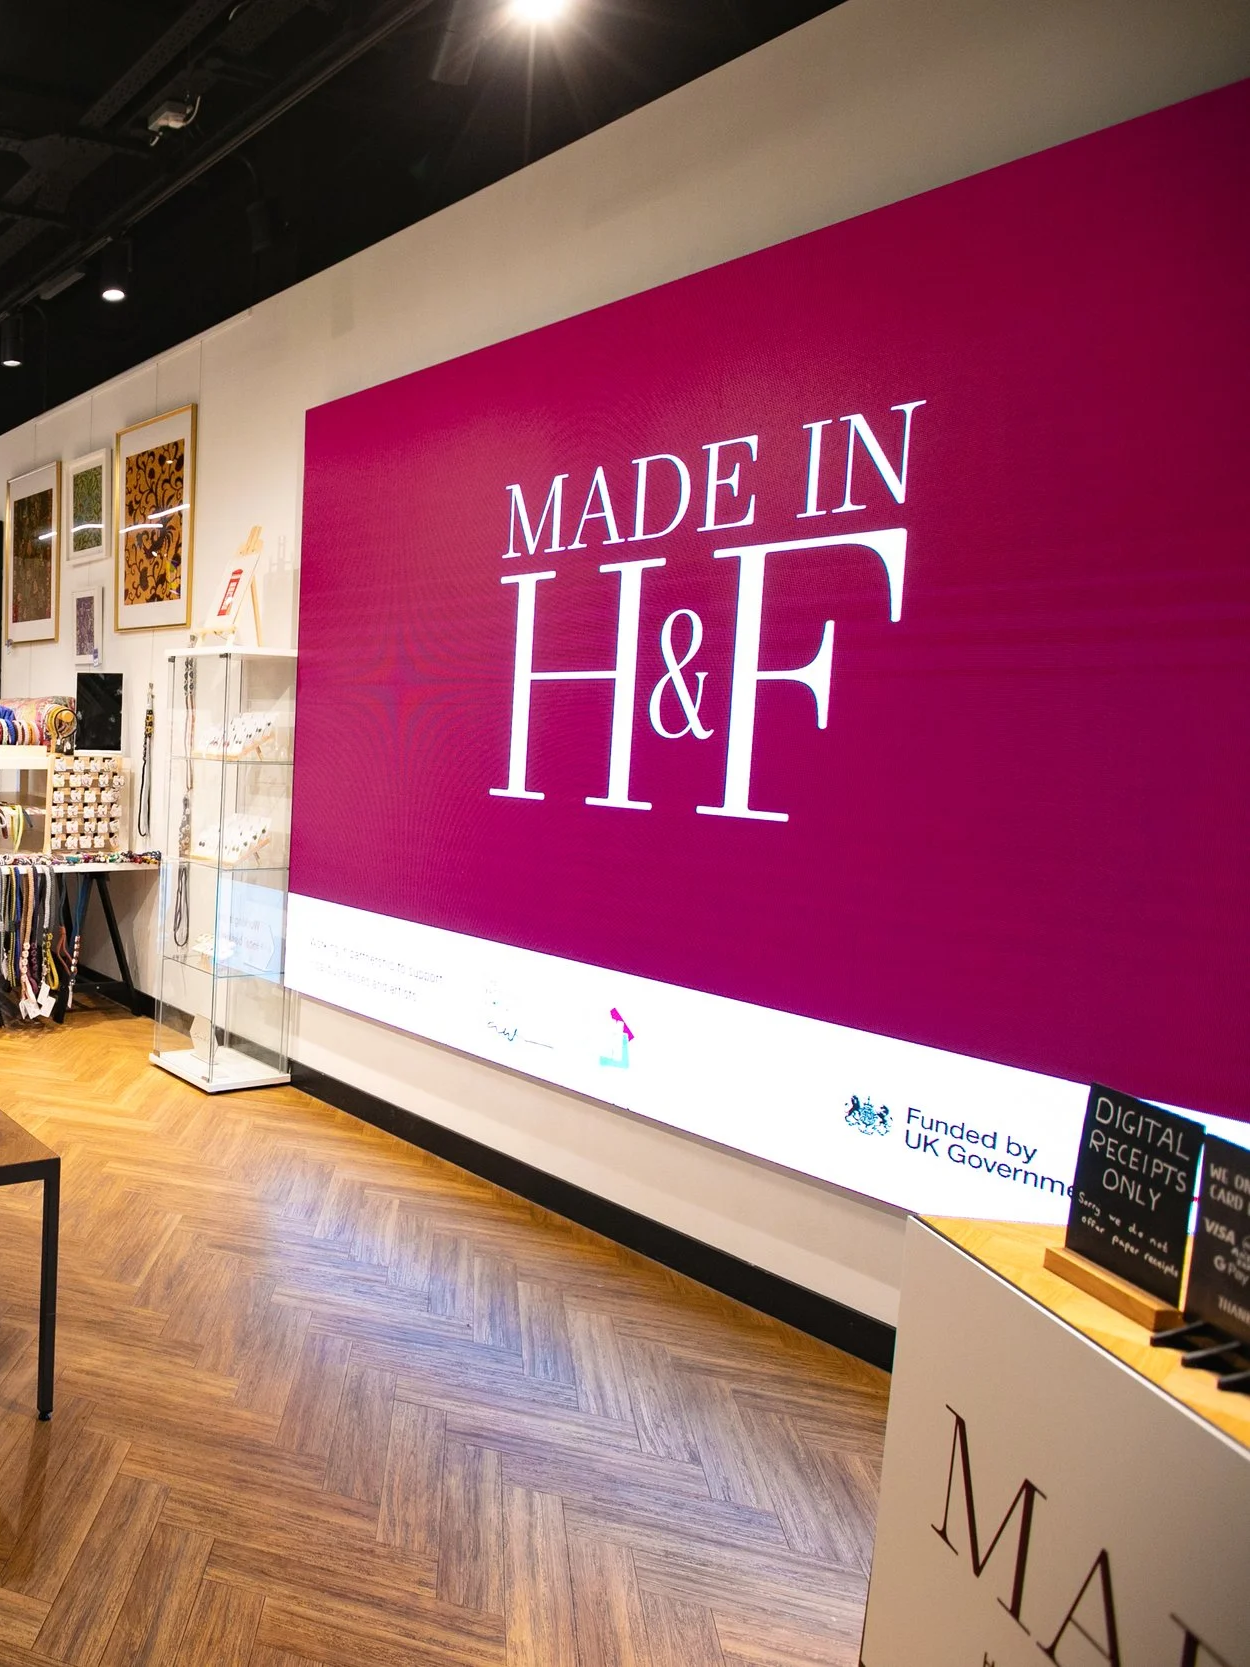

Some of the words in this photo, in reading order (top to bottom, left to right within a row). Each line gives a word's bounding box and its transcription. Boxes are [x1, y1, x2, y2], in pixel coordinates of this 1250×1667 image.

[502, 434, 759, 559] MADE
[797, 400, 927, 519] IN
[489, 527, 908, 823] H&F
[907, 1107, 998, 1150] Funded
[1007, 1136, 1038, 1164] by
[1089, 1129, 1187, 1192] RECEIPTS
[1095, 1097, 1190, 1161] DIGITAL
[905, 1129, 939, 1157] UK
[948, 1143, 1074, 1198] Governme
[1102, 1168, 1161, 1211] ONLY
[1210, 1162, 1229, 1185] WE
[1078, 1191, 1101, 1217] Sorry
[1108, 1213, 1121, 1227] we
[1128, 1221, 1144, 1239] do
[1150, 1236, 1168, 1254] not
[1209, 1182, 1244, 1212] CARD
[1081, 1215, 1105, 1234] offer
[1111, 1235, 1139, 1256] paper
[1144, 1251, 1179, 1278] receipts
[1203, 1216, 1236, 1246] VISA
